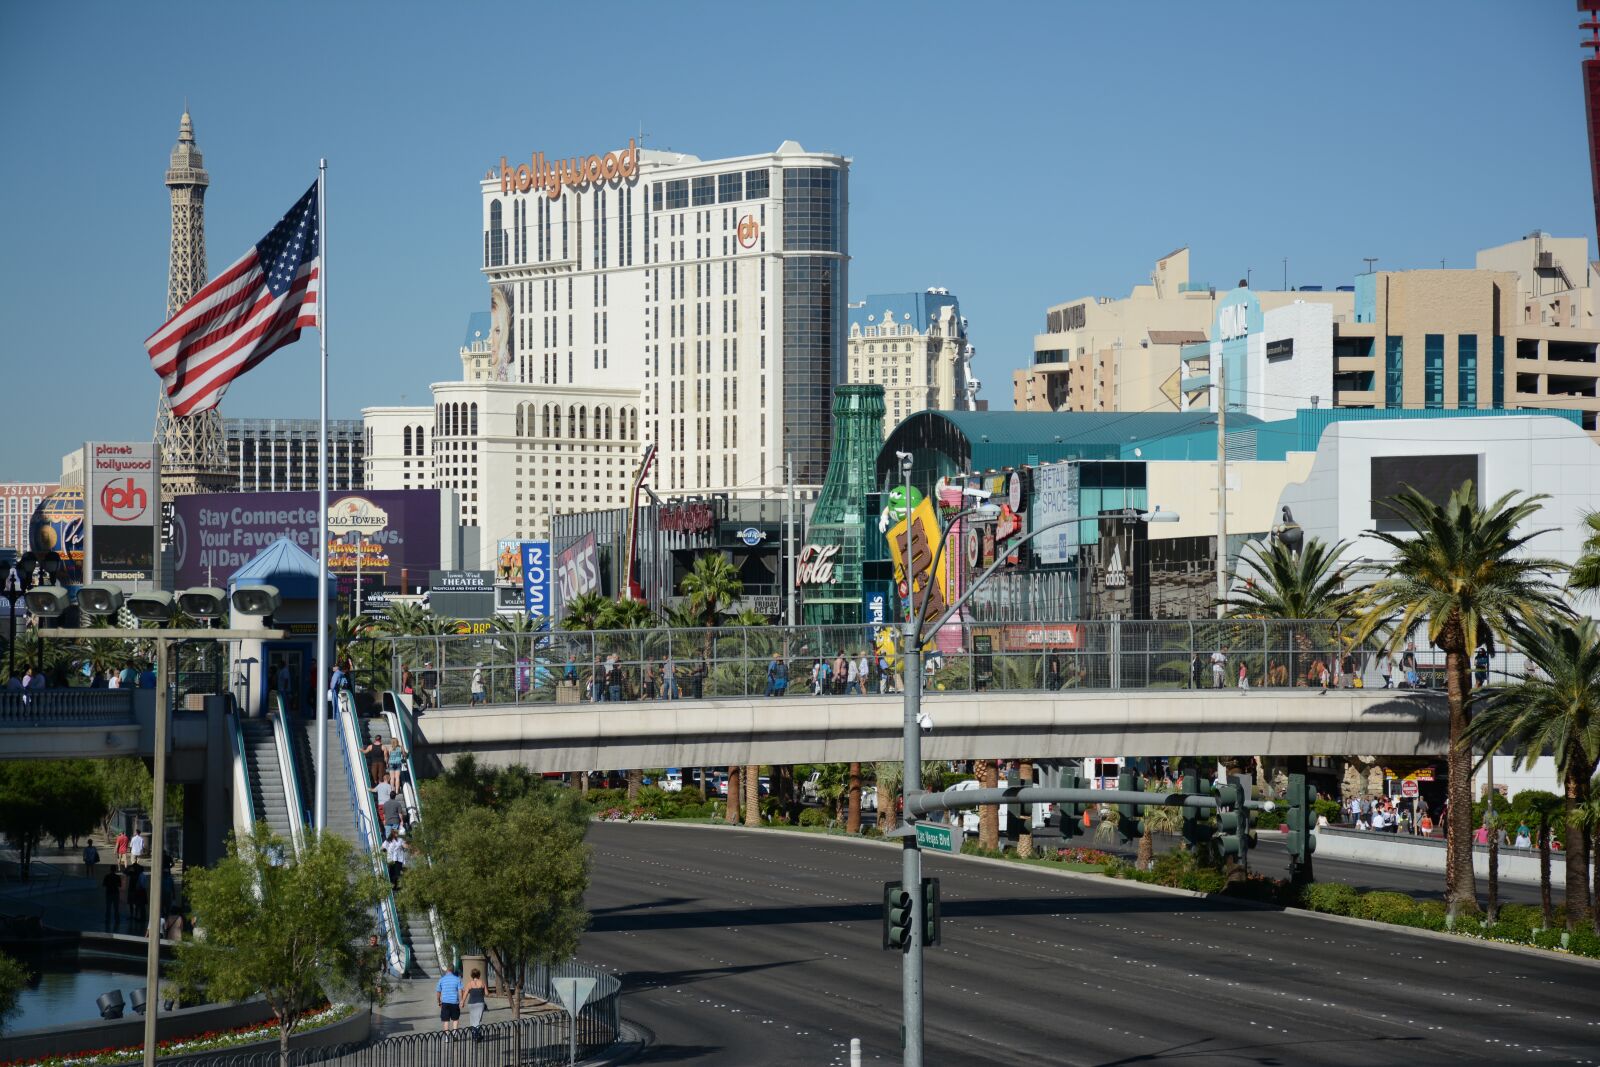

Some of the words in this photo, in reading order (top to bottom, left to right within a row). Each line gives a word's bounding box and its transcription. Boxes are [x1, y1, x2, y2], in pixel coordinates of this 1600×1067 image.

[501, 138, 636, 199] hollywood
[96, 445, 132, 456] planet
[96, 459, 151, 471] hollywood
[1042, 468, 1067, 489] RETAIL
[4, 487, 46, 495] ISLAND
[104, 478, 147, 518] ph
[1042, 491, 1067, 513] SPACE
[199, 508, 229, 529] Stay
[231, 507, 320, 526] Connecte
[328, 516, 347, 525] OLO
[350, 515, 386, 525] TOWERS
[200, 529, 231, 547] Your
[200, 549, 217, 566] All
[101, 571, 145, 579] Panasonic
[559, 546, 596, 607] ROSS
[1105, 570, 1125, 586] adidas
[1029, 571, 1072, 621] RESORTS
[926, 832, 939, 847] Vegas
[939, 833, 950, 846] Blvd
